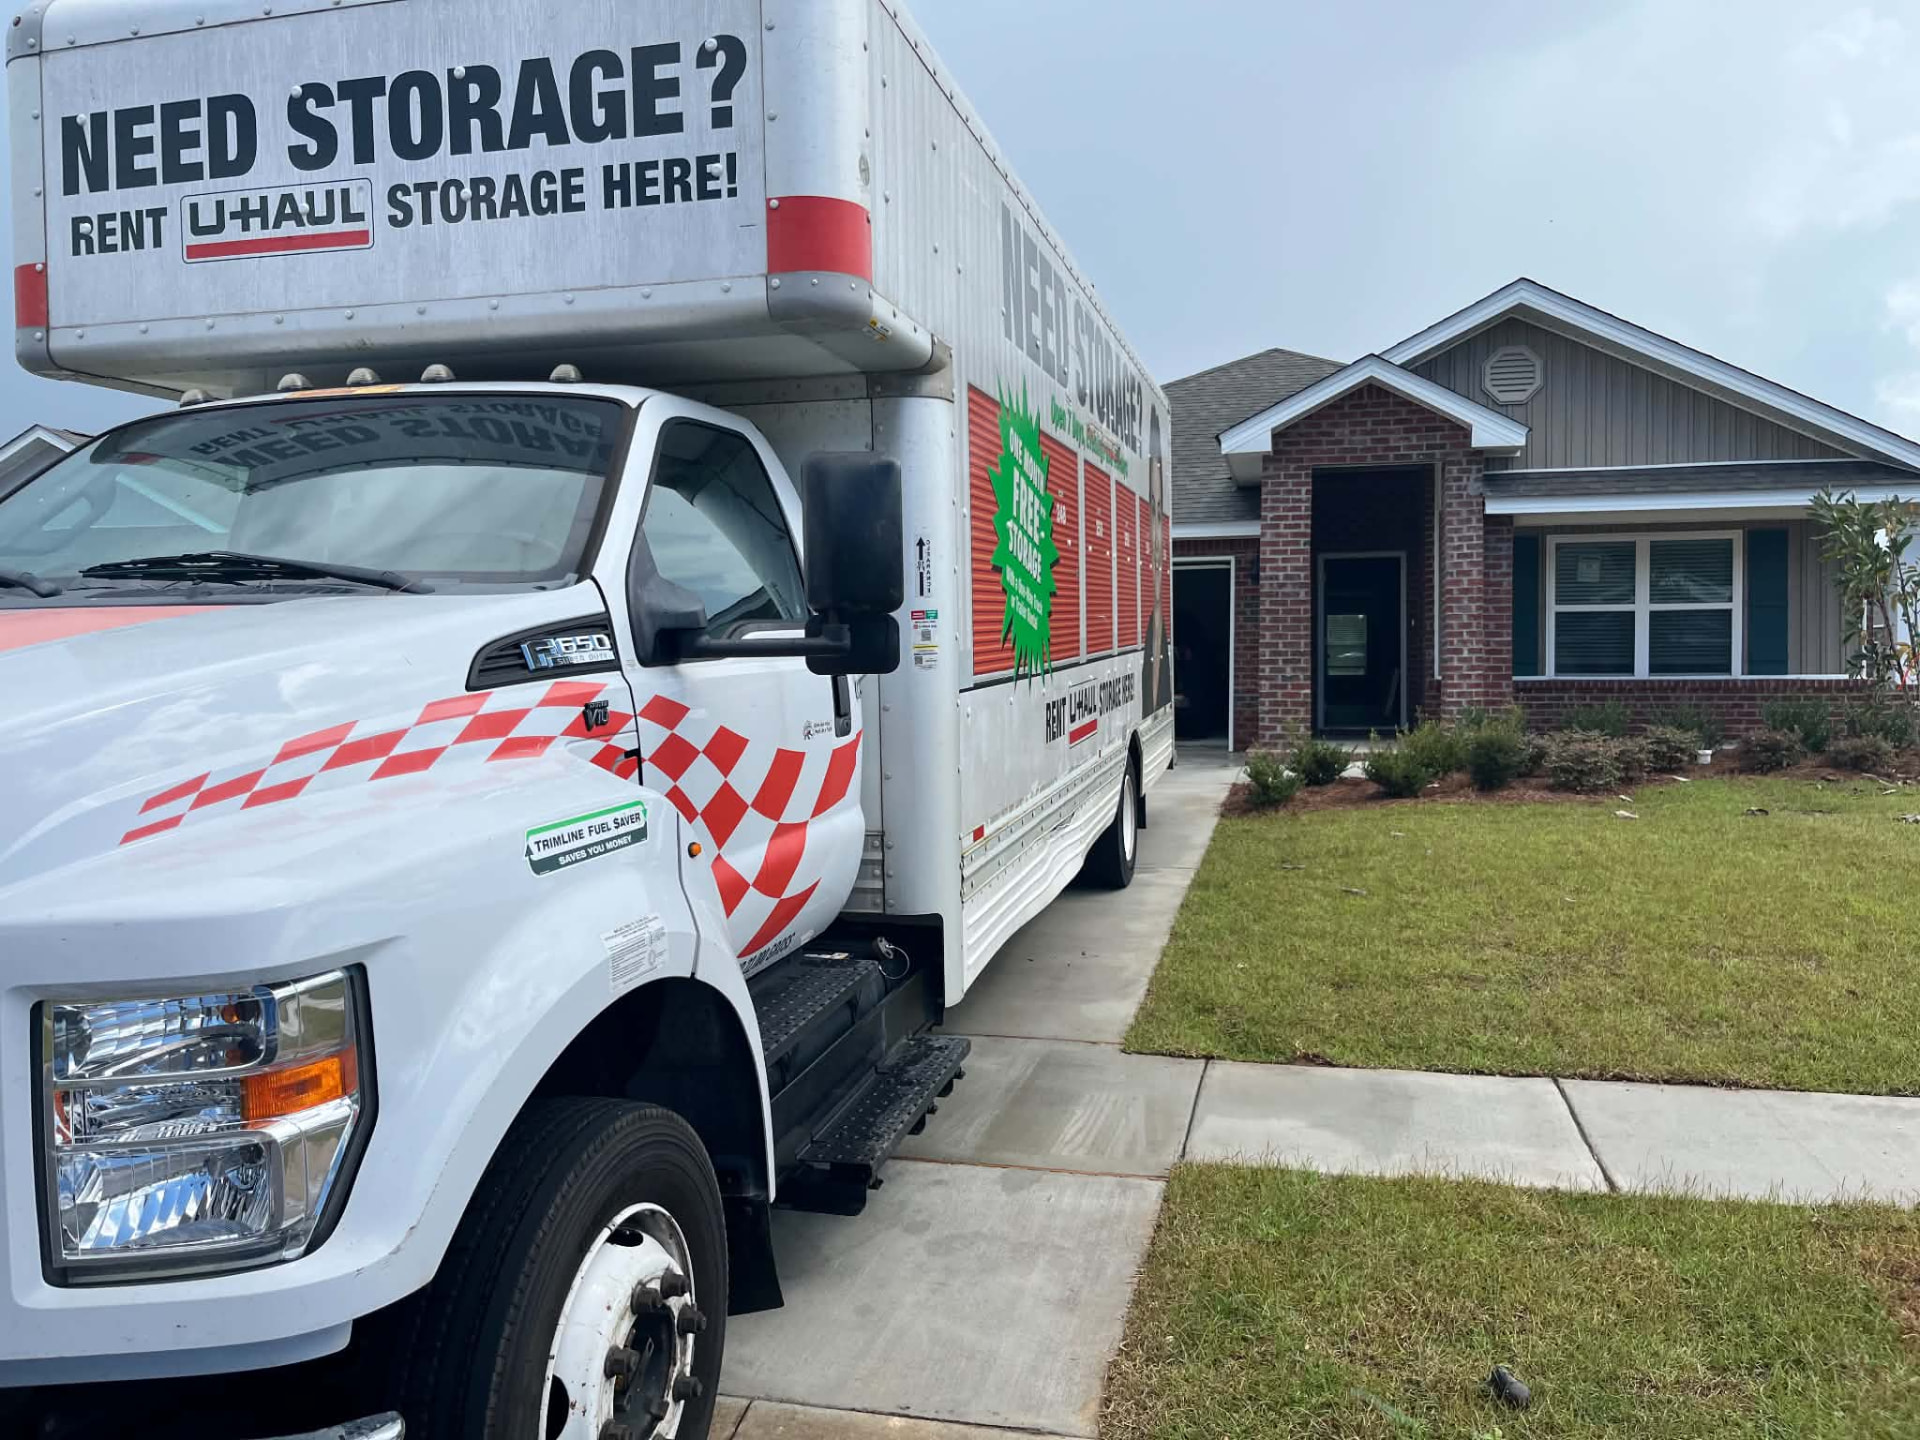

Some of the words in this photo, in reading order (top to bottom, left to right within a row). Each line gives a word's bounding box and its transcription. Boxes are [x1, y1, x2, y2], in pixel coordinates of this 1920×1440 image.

[61, 93, 257, 196] NEED
[287, 34, 747, 171] STORAGE?
[71, 206, 168, 256] RENT
[189, 187, 366, 237] U-HAUL
[387, 167, 586, 229] STORAGE
[602, 152, 738, 209] HERE!
[1001, 199, 1069, 389] NEED
[1073, 295, 1143, 458] STORAGE?
[1009, 427, 1022, 466] ONE
[1023, 447, 1045, 497] MONTH
[1008, 520, 1042, 585] STORAGE
[1045, 696, 1067, 744] RENT
[534, 828, 585, 853] TRIMLINE
[588, 821, 611, 837] FUEL
[558, 848, 588, 865] SAVES
[587, 842, 605, 857] YOU
[606, 834, 633, 850] MONEY
